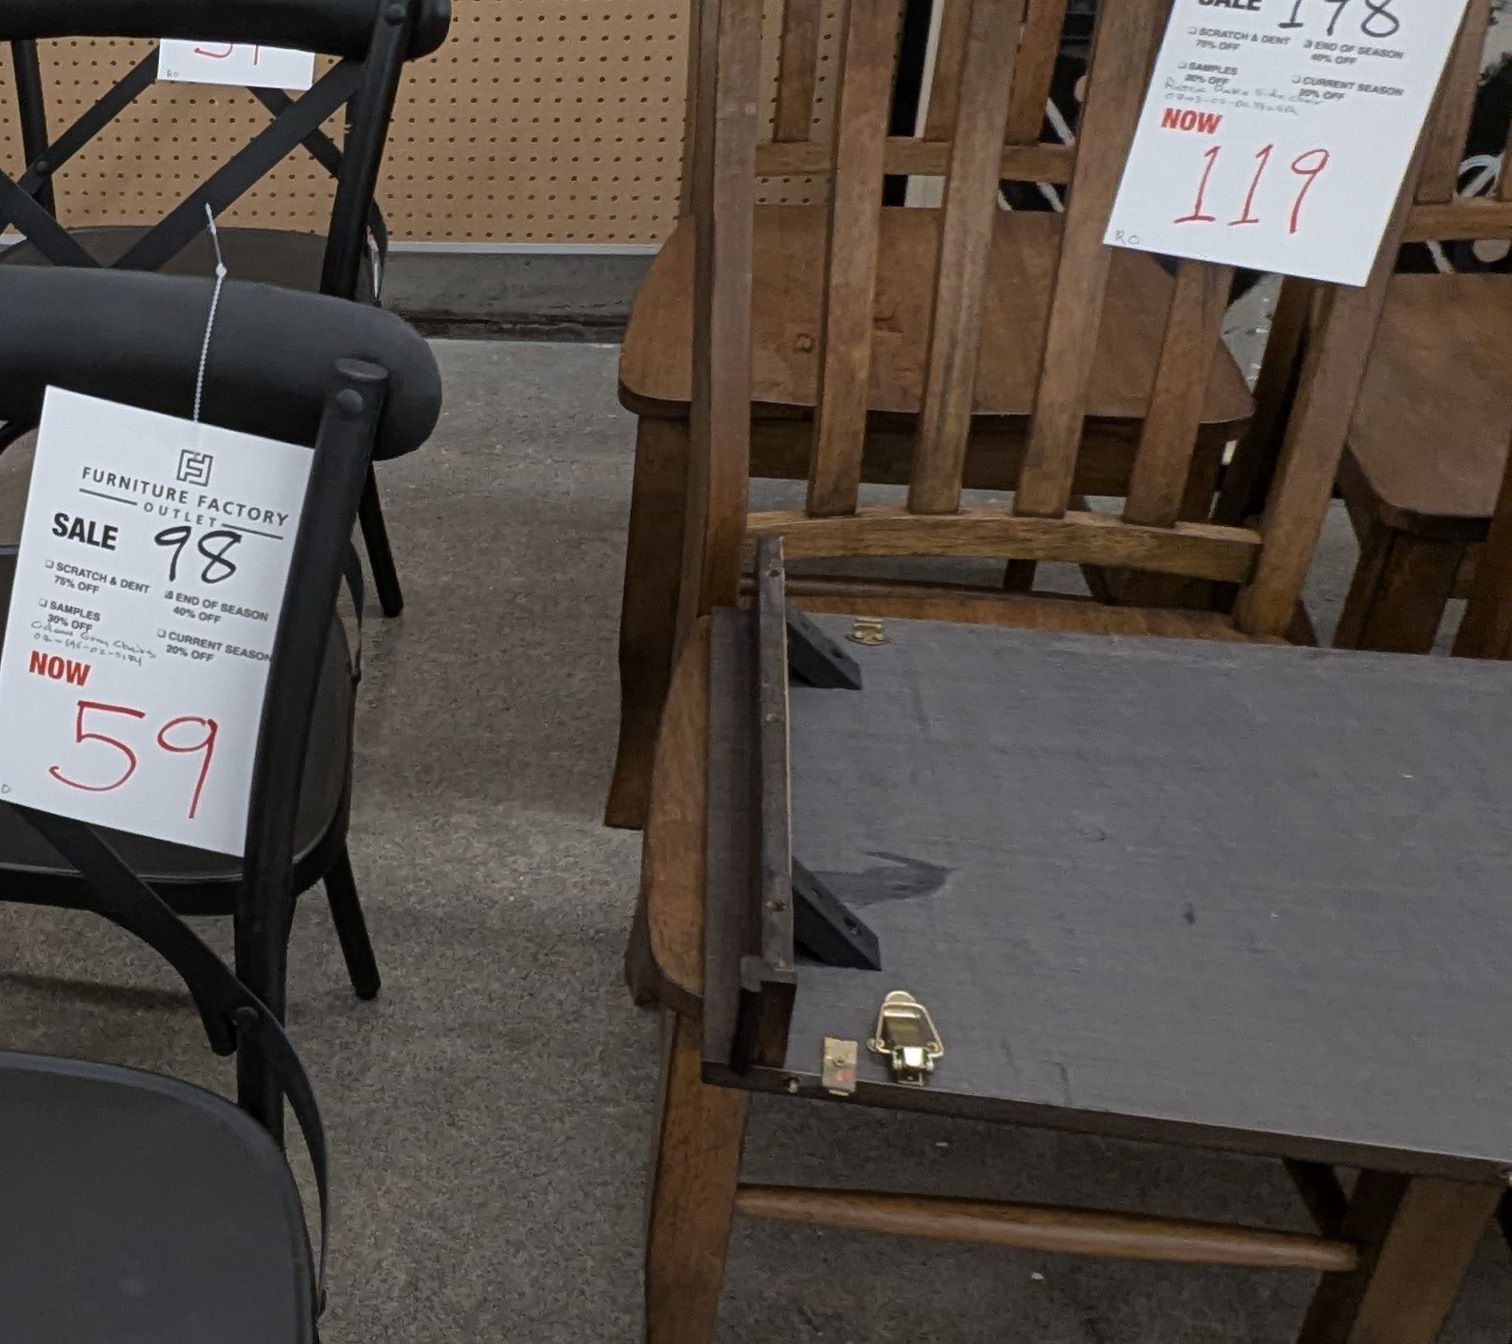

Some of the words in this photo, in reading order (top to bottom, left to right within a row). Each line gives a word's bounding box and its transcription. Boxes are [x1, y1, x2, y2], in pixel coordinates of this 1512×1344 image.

[1199, 27, 1248, 41] SCRATCH
[1251, 34, 1258, 42] &
[1261, 35, 1291, 45] DENT
[1218, 41, 1240, 51] OFF
[1357, 46, 1405, 59] SEASON
[1188, 62, 1238, 76] SAMPLES
[1303, 76, 1355, 90] CURRENT
[1357, 83, 1404, 96] SEASON
[1161, 107, 1223, 134] NOW
[1173, 144, 1330, 234] 119
[82, 466, 188, 504] FURNITURE
[197, 495, 289, 527] FACTORY
[144, 502, 217, 528] OUTLET
[52, 512, 118, 551] SALE
[154, 525, 242, 585] 98
[54, 575, 75, 589] 75%
[78, 581, 100, 594] OFF
[56, 562, 107, 584] SCRATCH
[109, 576, 117, 586] &
[120, 578, 150, 594] DENT
[50, 601, 101, 622] SAMPLES
[173, 606, 196, 619] 40%
[198, 611, 221, 623] OFF
[176, 592, 200, 606] END
[202, 598, 219, 609] OF
[220, 603, 269, 622] SEASON
[48, 613, 69, 627] 30%
[71, 620, 93, 633] OFF
[168, 631, 223, 651] CURRENT
[166, 644, 188, 657] 20%
[191, 650, 214, 662] OFF
[29, 650, 91, 686] NOW
[49, 700, 218, 819] 59
